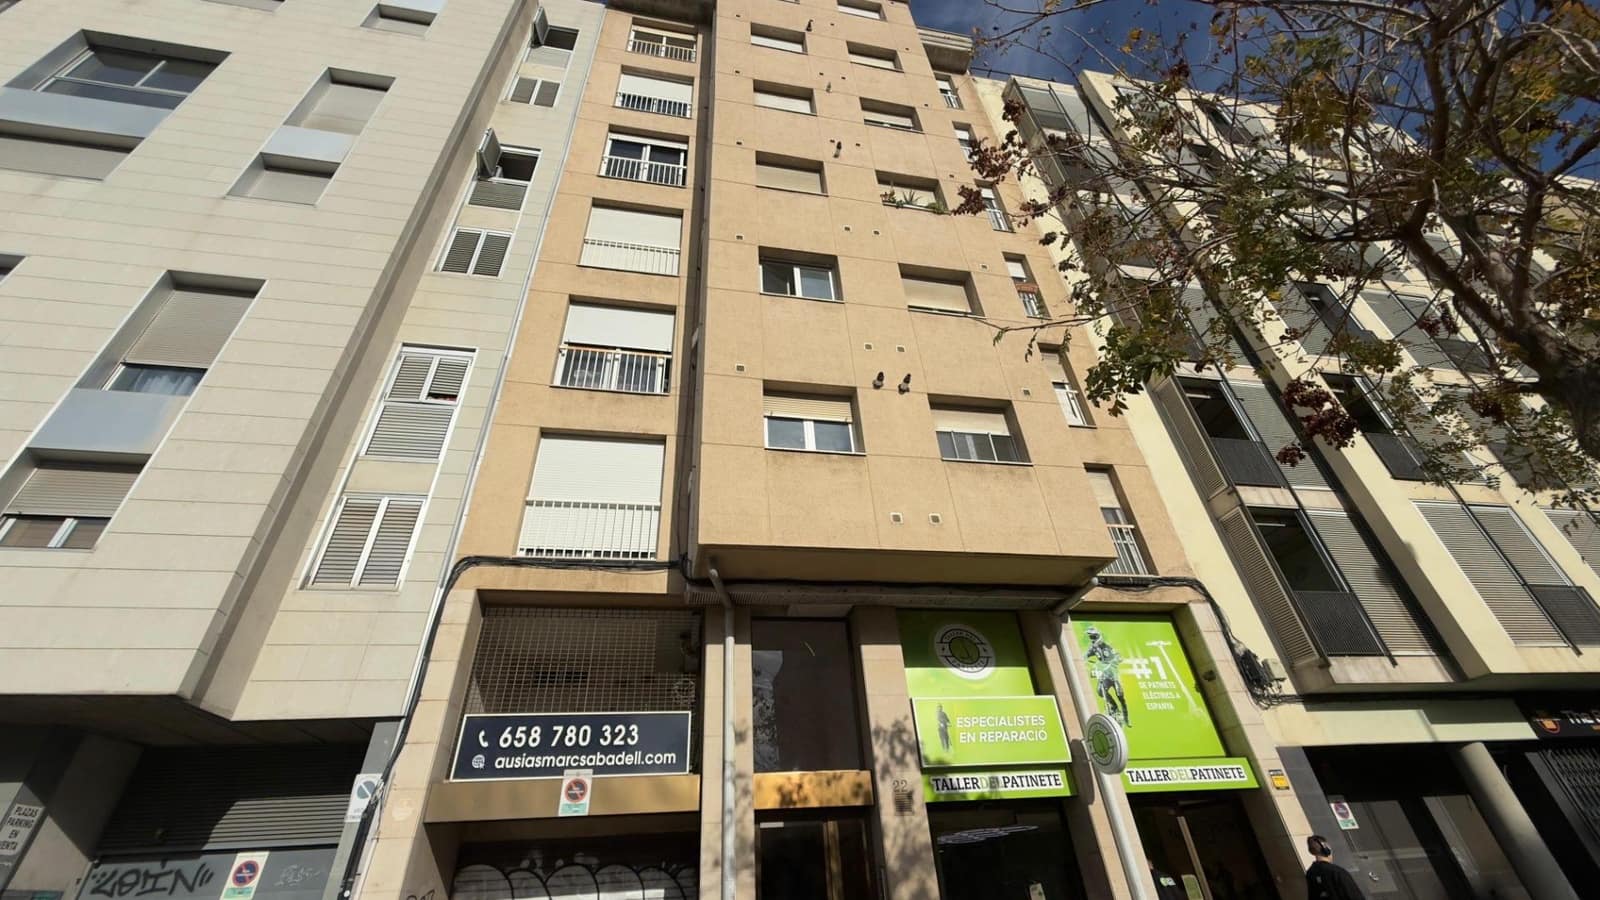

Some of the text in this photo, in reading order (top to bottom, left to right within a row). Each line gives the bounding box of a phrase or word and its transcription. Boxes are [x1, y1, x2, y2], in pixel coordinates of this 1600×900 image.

[1131, 656, 1167, 680] #1
[956, 715, 1046, 728] ESPECIALISTES
[499, 724, 639, 748] 658 780 323
[960, 727, 1048, 743] EN REPARACIÓ
[494, 751, 677, 769] ausiasmarcsabadell.com
[892, 779, 908, 792] 22
[15, 806, 38, 817] PLAZAS
[7, 816, 35, 828] PARKING
[9, 829, 19, 839] EN
